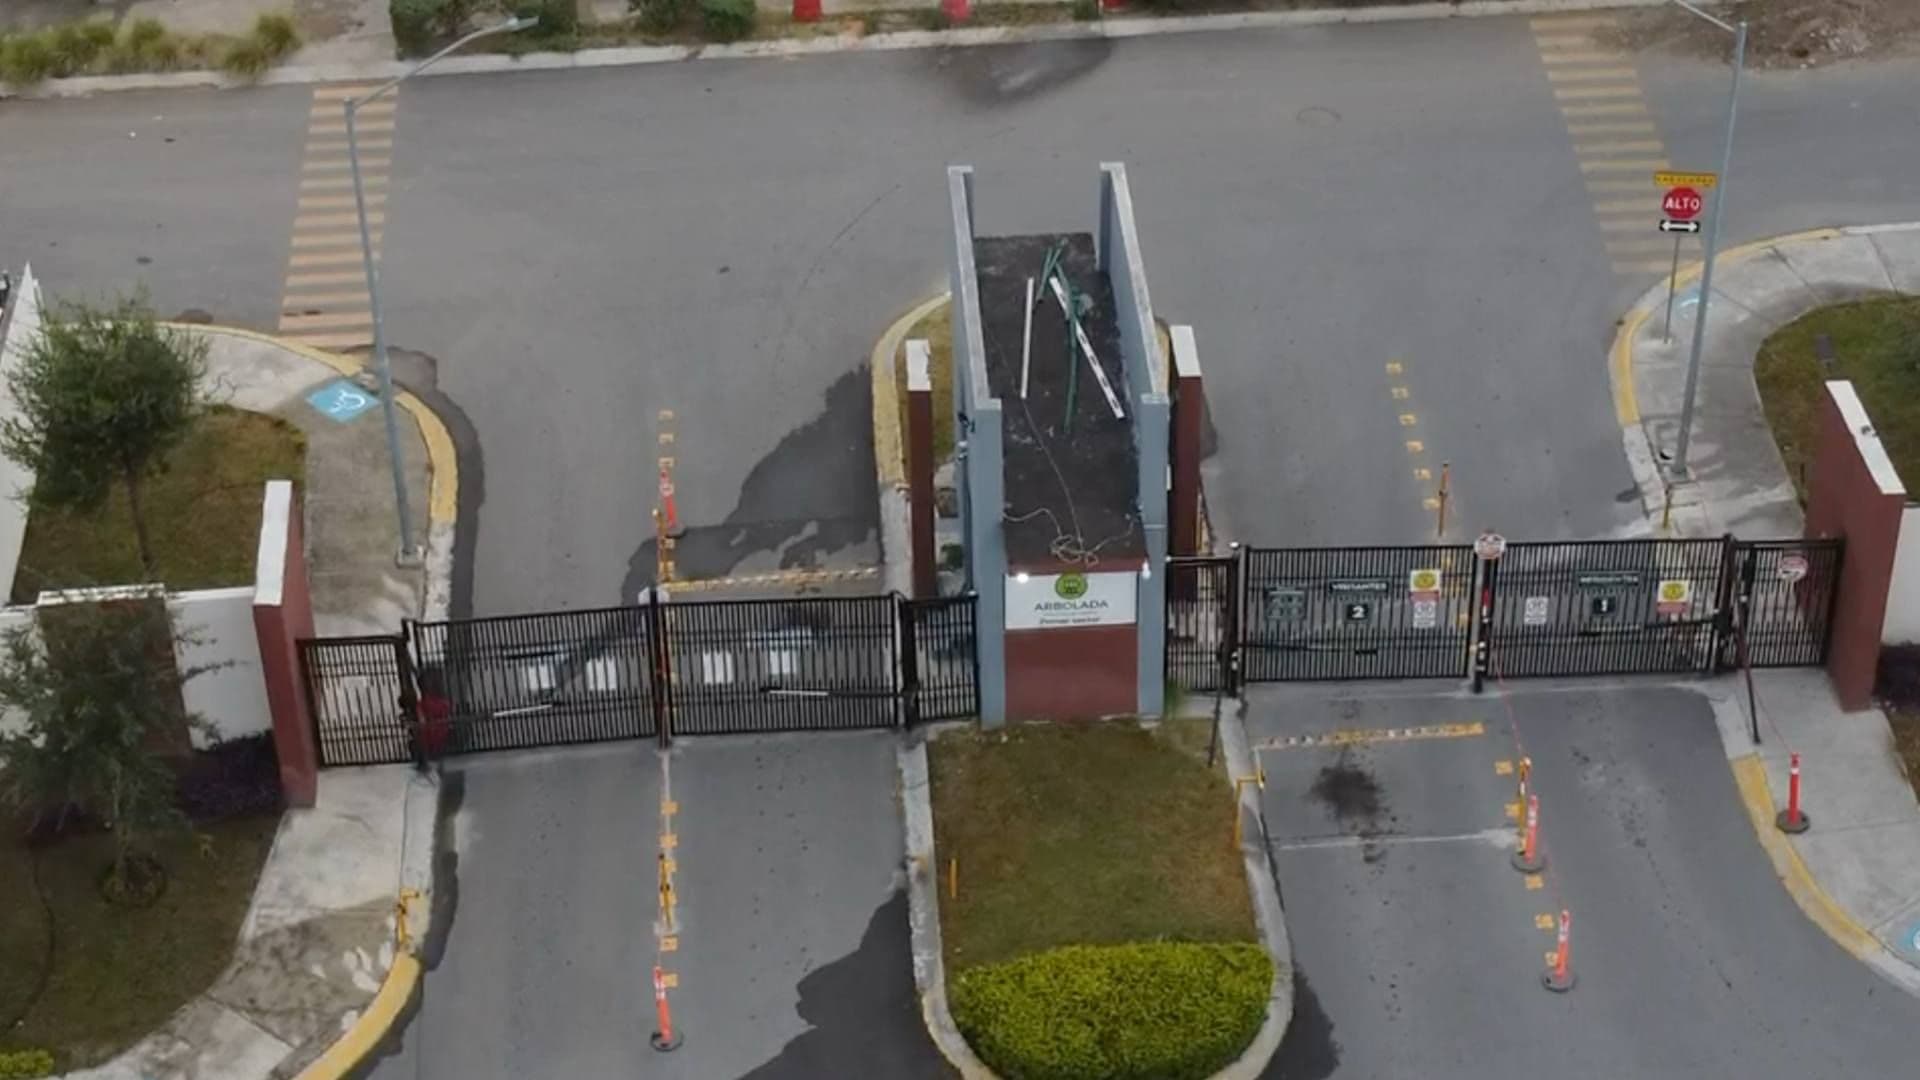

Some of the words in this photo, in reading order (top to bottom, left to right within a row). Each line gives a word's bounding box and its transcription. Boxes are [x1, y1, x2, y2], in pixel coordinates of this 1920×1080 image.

[1665, 197, 1700, 210] ALTO
[1035, 600, 1109, 611] ARBOLADA
[1352, 606, 1366, 619] 2
